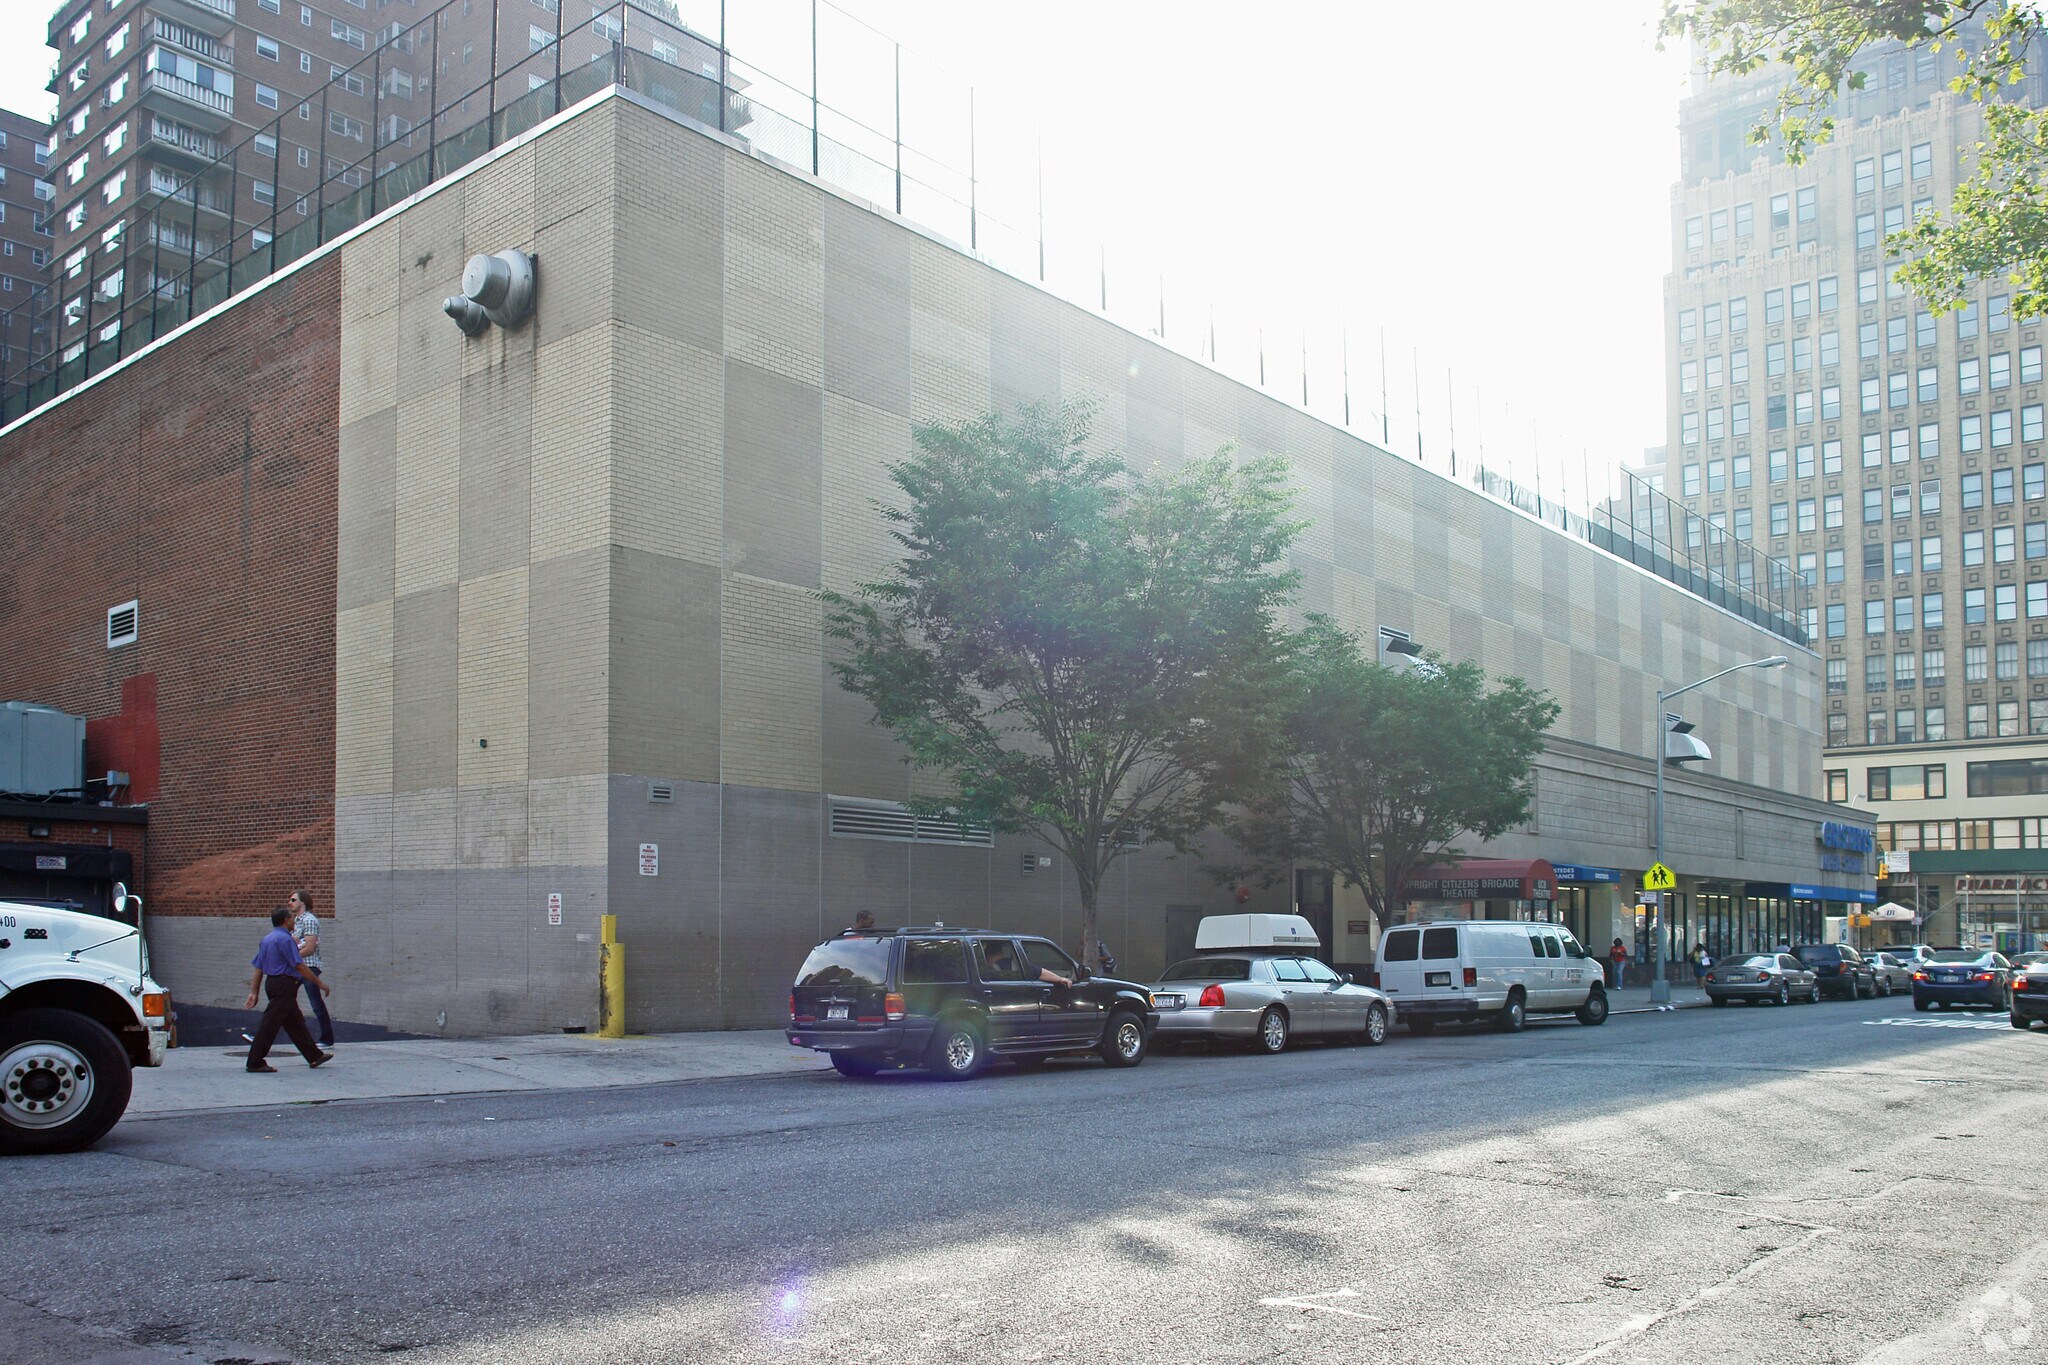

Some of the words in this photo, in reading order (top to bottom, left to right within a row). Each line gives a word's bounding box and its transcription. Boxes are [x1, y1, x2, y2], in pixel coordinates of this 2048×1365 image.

[1441, 879, 1479, 889] CITIZENS
[1481, 878, 1520, 888] BRIGADE
[1441, 888, 1479, 898] THEATRE
